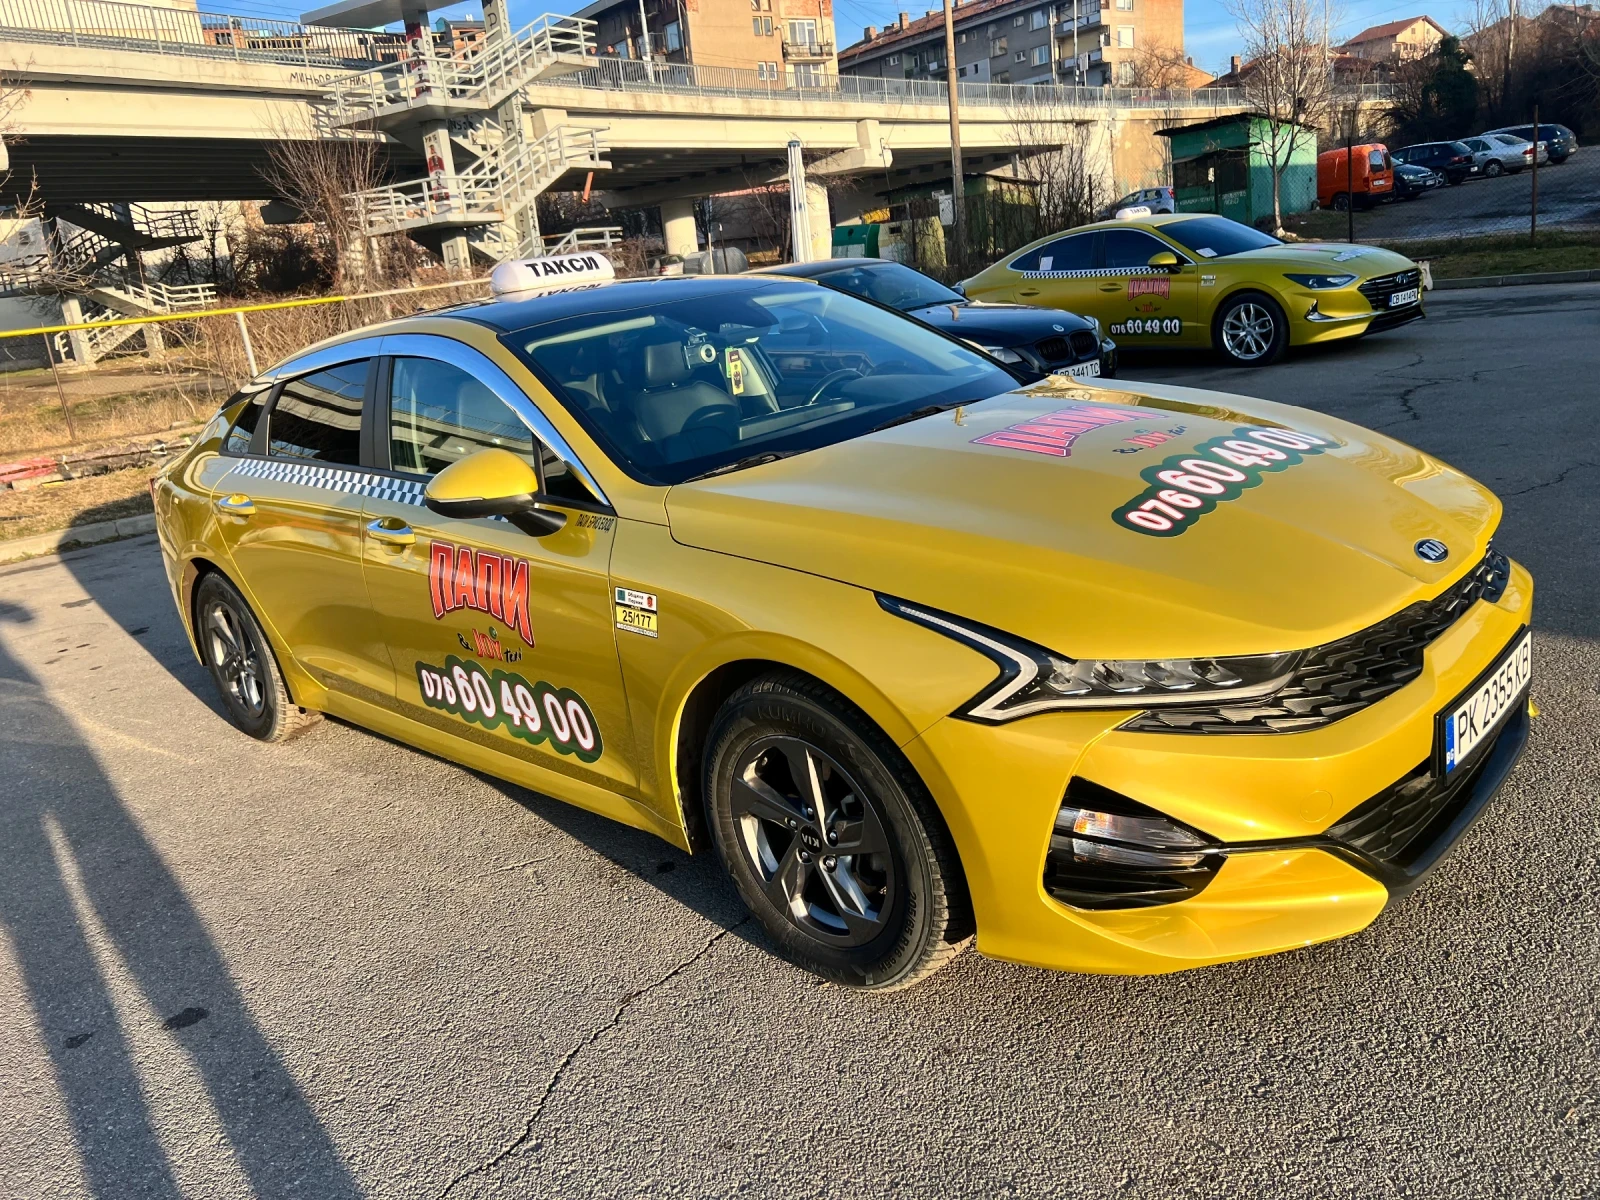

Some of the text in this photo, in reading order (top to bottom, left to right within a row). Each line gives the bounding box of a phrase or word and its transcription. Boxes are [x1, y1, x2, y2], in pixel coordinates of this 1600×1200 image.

[524, 256, 600, 277] ТАКСИ
[1128, 276, 1170, 301] ПАПИ
[1111, 319, 1180, 334] 076 60 49 00
[969, 405, 1168, 457] ПАПИ
[1126, 427, 1328, 531] 076 60 49 00
[428, 539, 535, 648] ПАПИ
[622, 609, 652, 628] 25/177
[421, 665, 595, 751] 076 60 49 00
[1458, 641, 1529, 754] PK 2355 KB
[1446, 748, 1454, 765] BG
[801, 833, 820, 848] KIA
